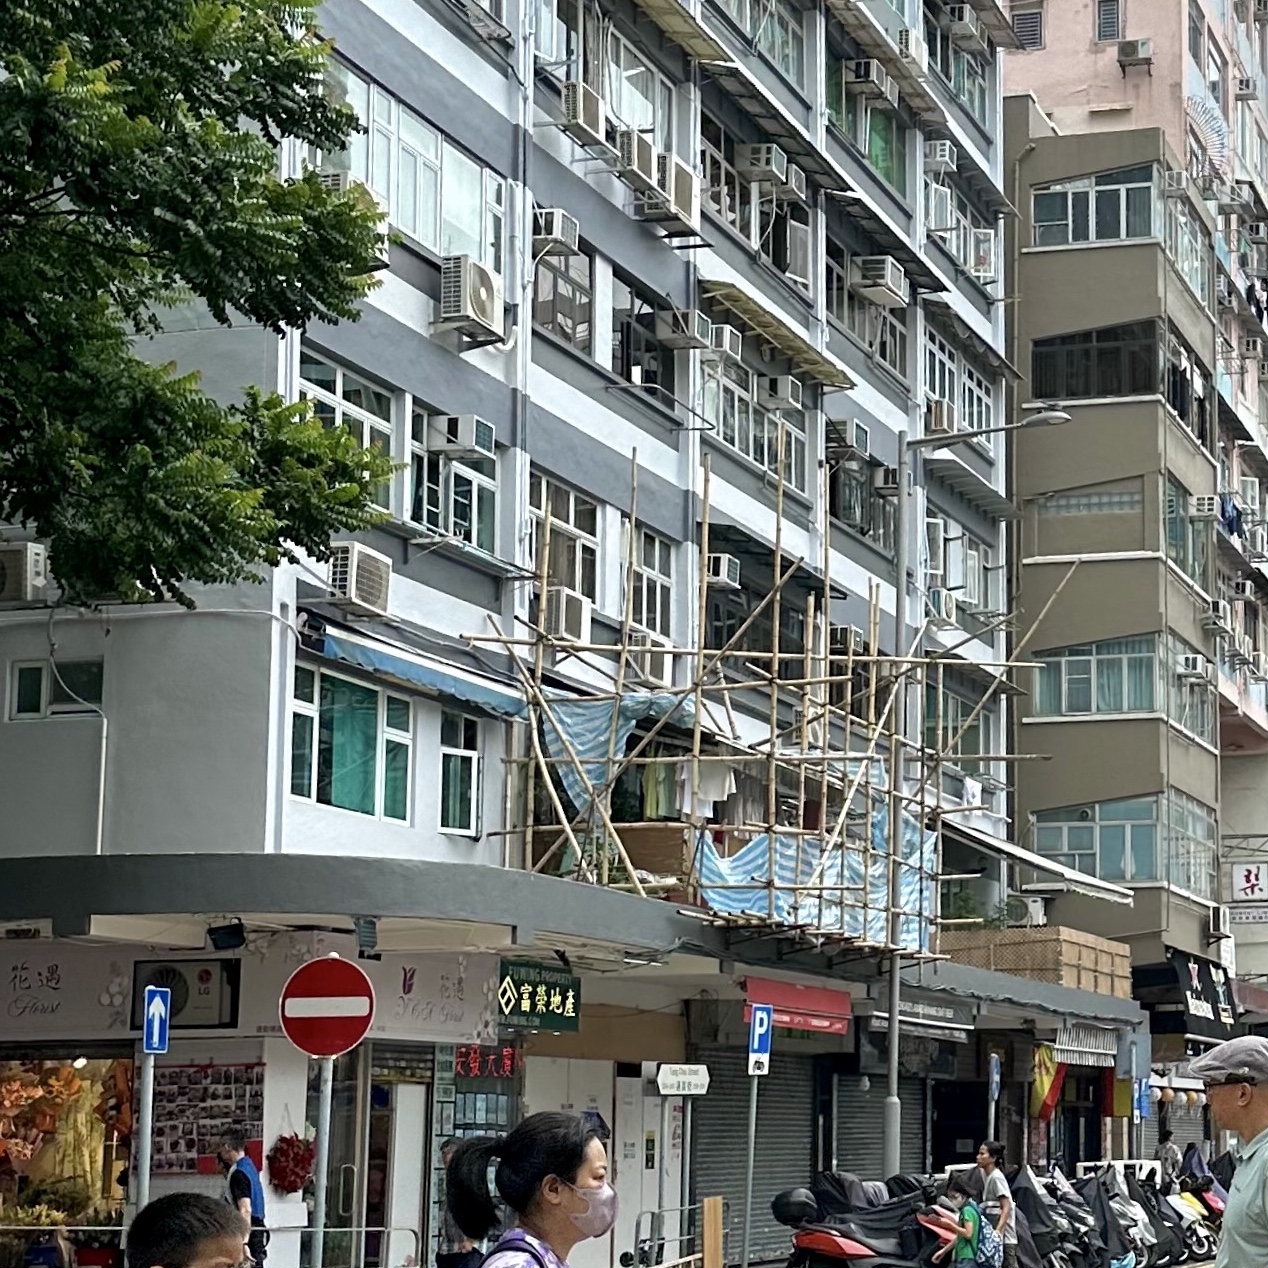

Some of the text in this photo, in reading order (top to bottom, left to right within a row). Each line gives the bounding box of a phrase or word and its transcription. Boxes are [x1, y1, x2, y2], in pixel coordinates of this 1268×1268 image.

[198, 986, 211, 996] LG
[520, 982, 576, 1017] 富榮地產
[753, 1010, 769, 1050] P
